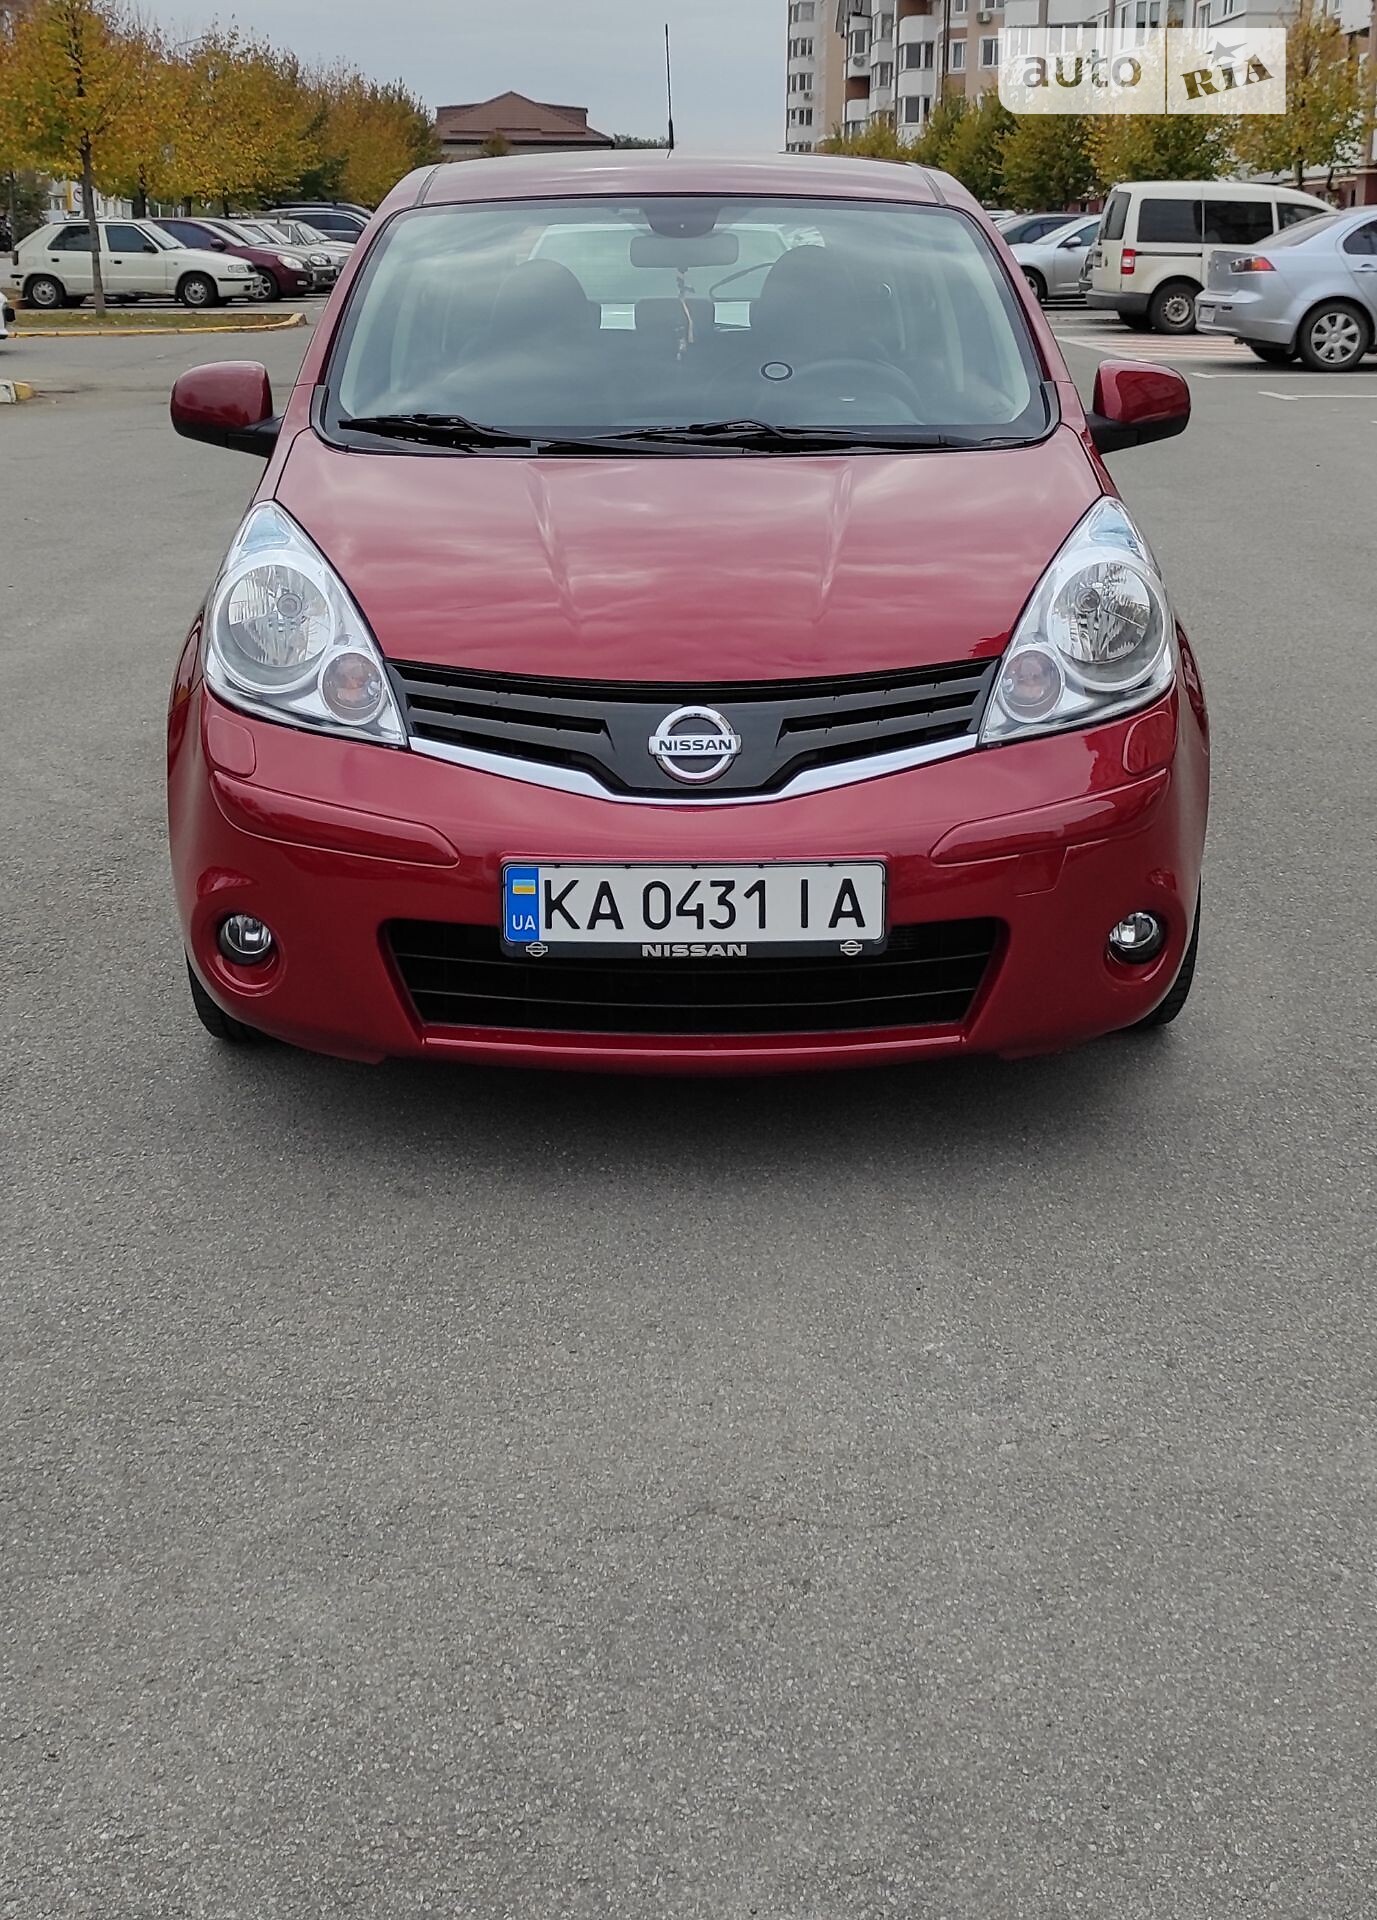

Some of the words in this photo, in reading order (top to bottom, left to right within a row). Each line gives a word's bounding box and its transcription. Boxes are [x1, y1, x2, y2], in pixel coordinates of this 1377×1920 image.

[658, 739, 732, 751] NISSAN
[544, 879, 624, 930] KA
[642, 880, 766, 930] 0431
[800, 878, 866, 929] IA
[512, 914, 536, 930] UA
[642, 943, 747, 957] NISSAN
